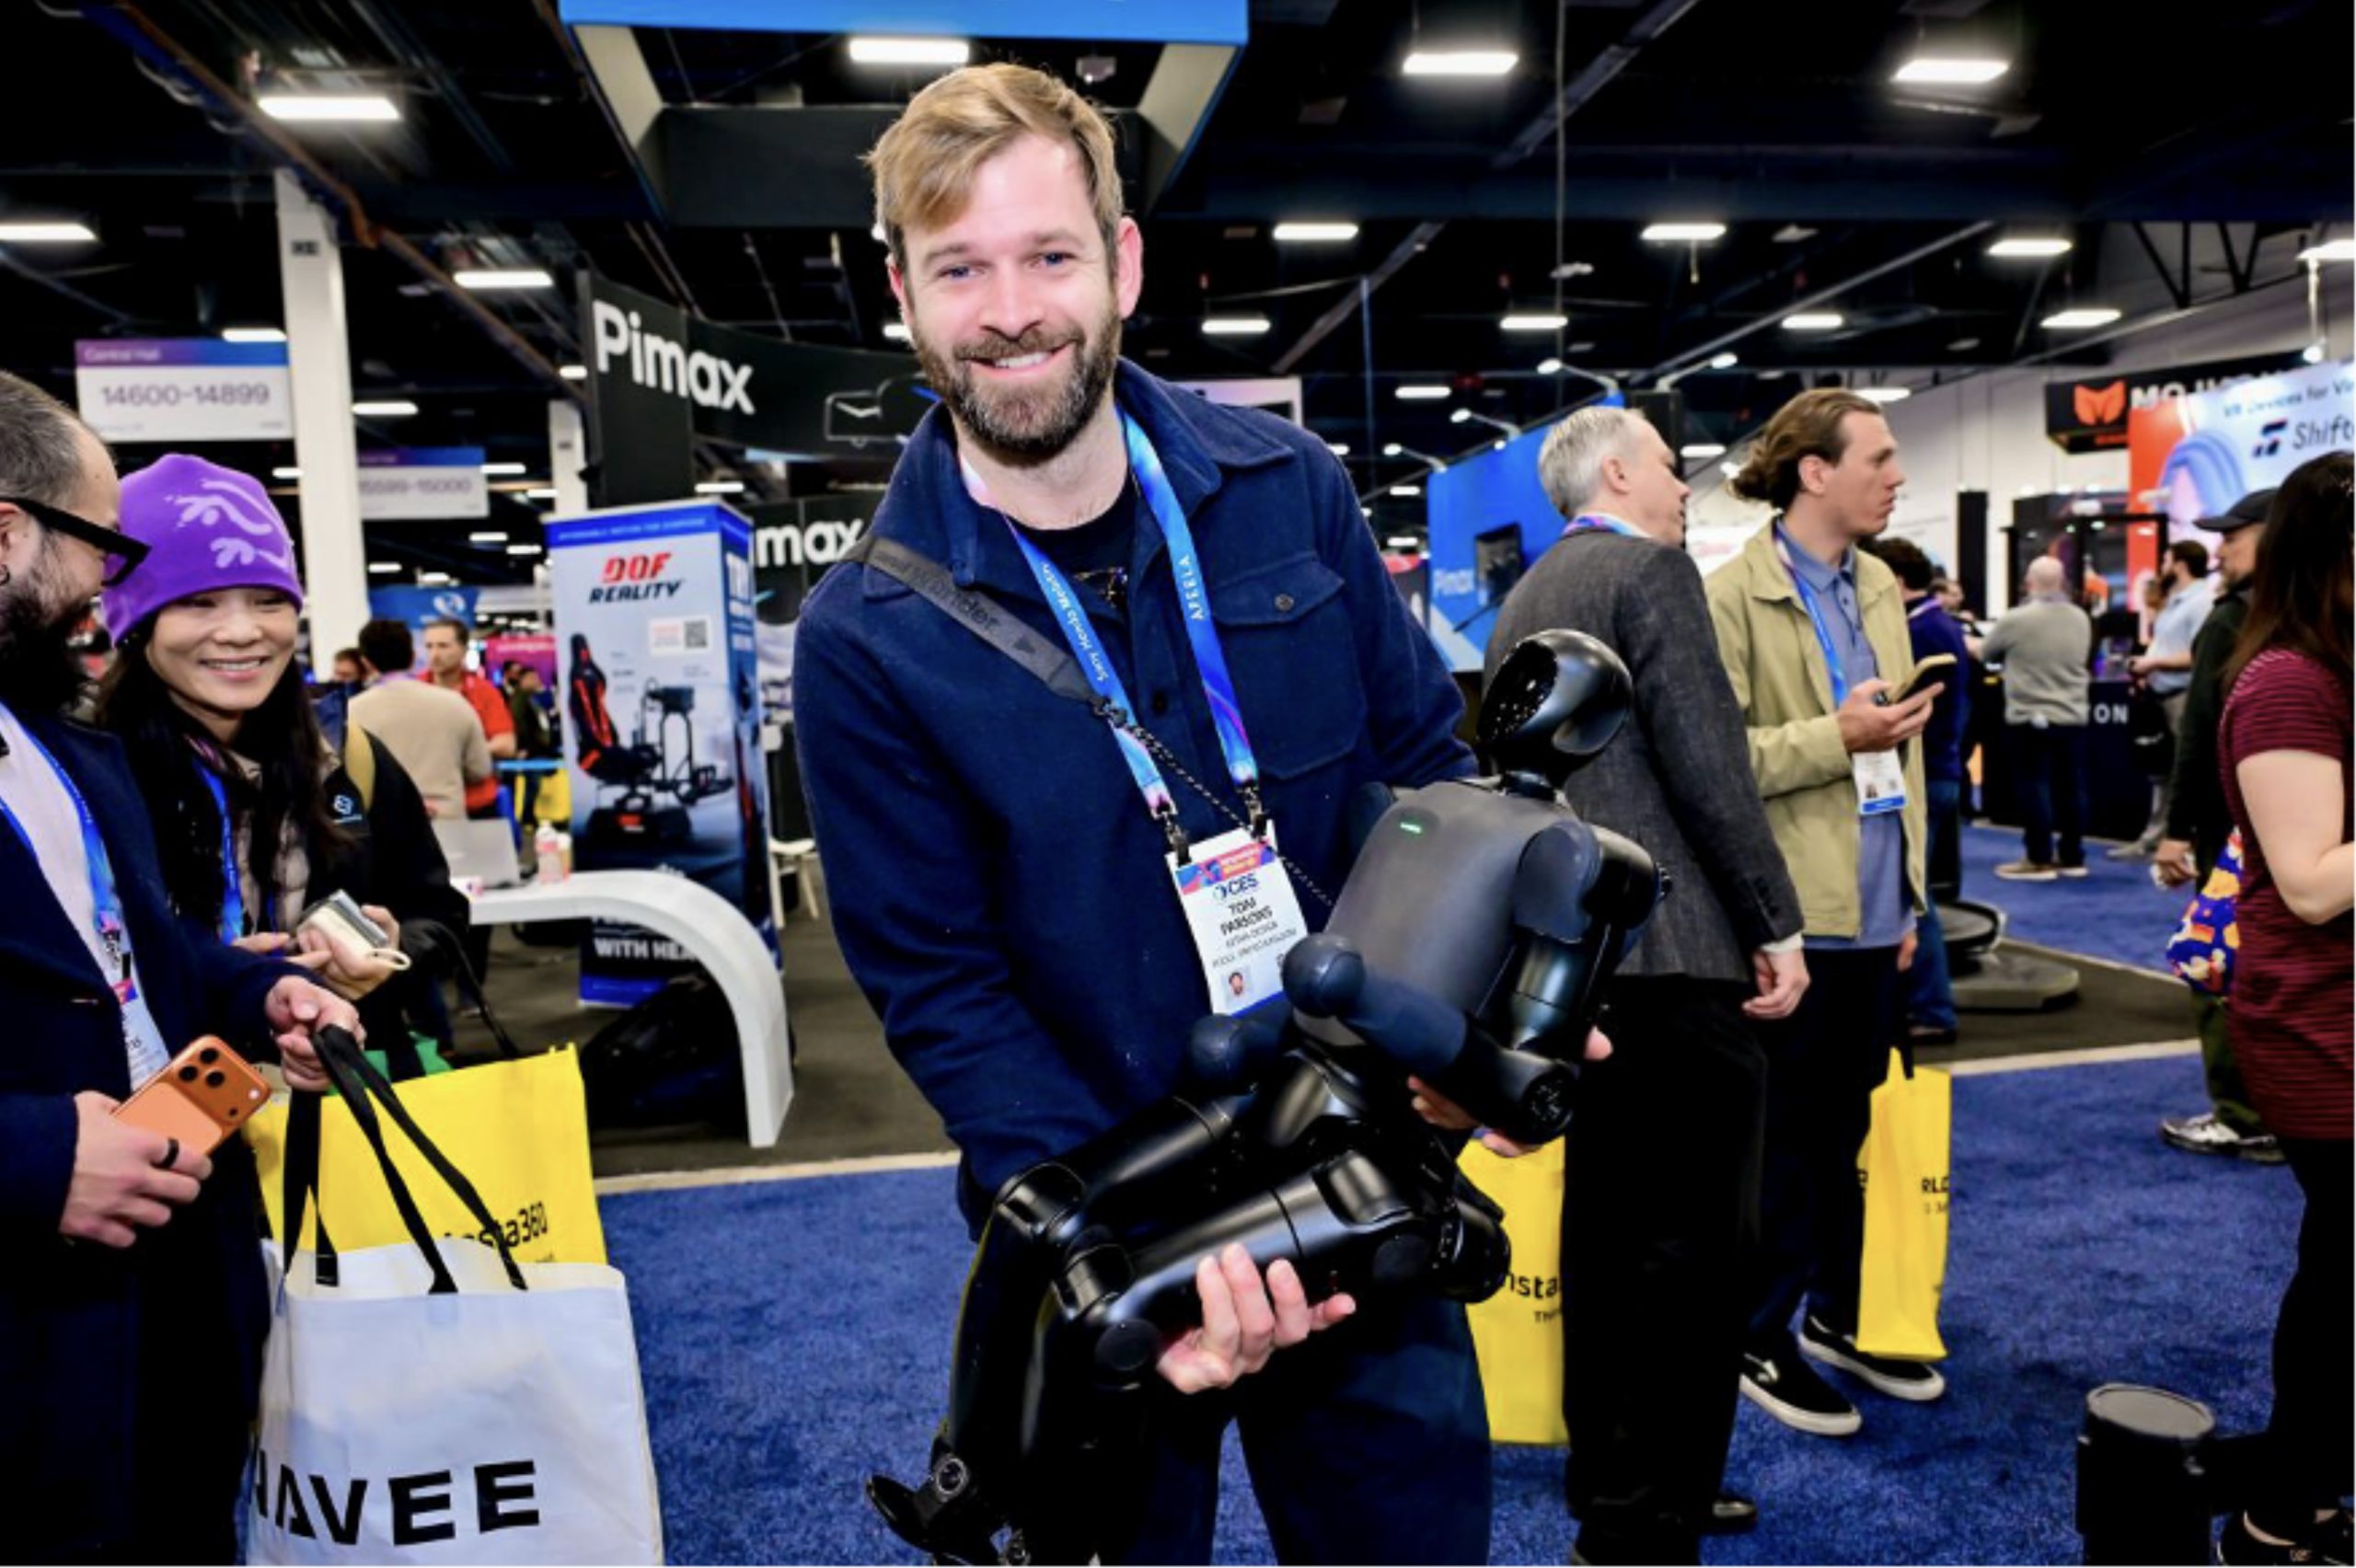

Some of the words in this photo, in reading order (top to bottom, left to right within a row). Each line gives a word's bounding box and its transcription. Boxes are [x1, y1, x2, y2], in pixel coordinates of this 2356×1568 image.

[593, 298, 755, 416] Pimax
[101, 383, 271, 407] 14600-14899
[2306, 383, 2329, 398] for
[588, 580, 683, 605] REALITY
[1178, 554, 1206, 621] AFEELA
[1228, 872, 1259, 896] CES
[1227, 895, 1257, 916] TOM
[594, 938, 648, 958] WITH
